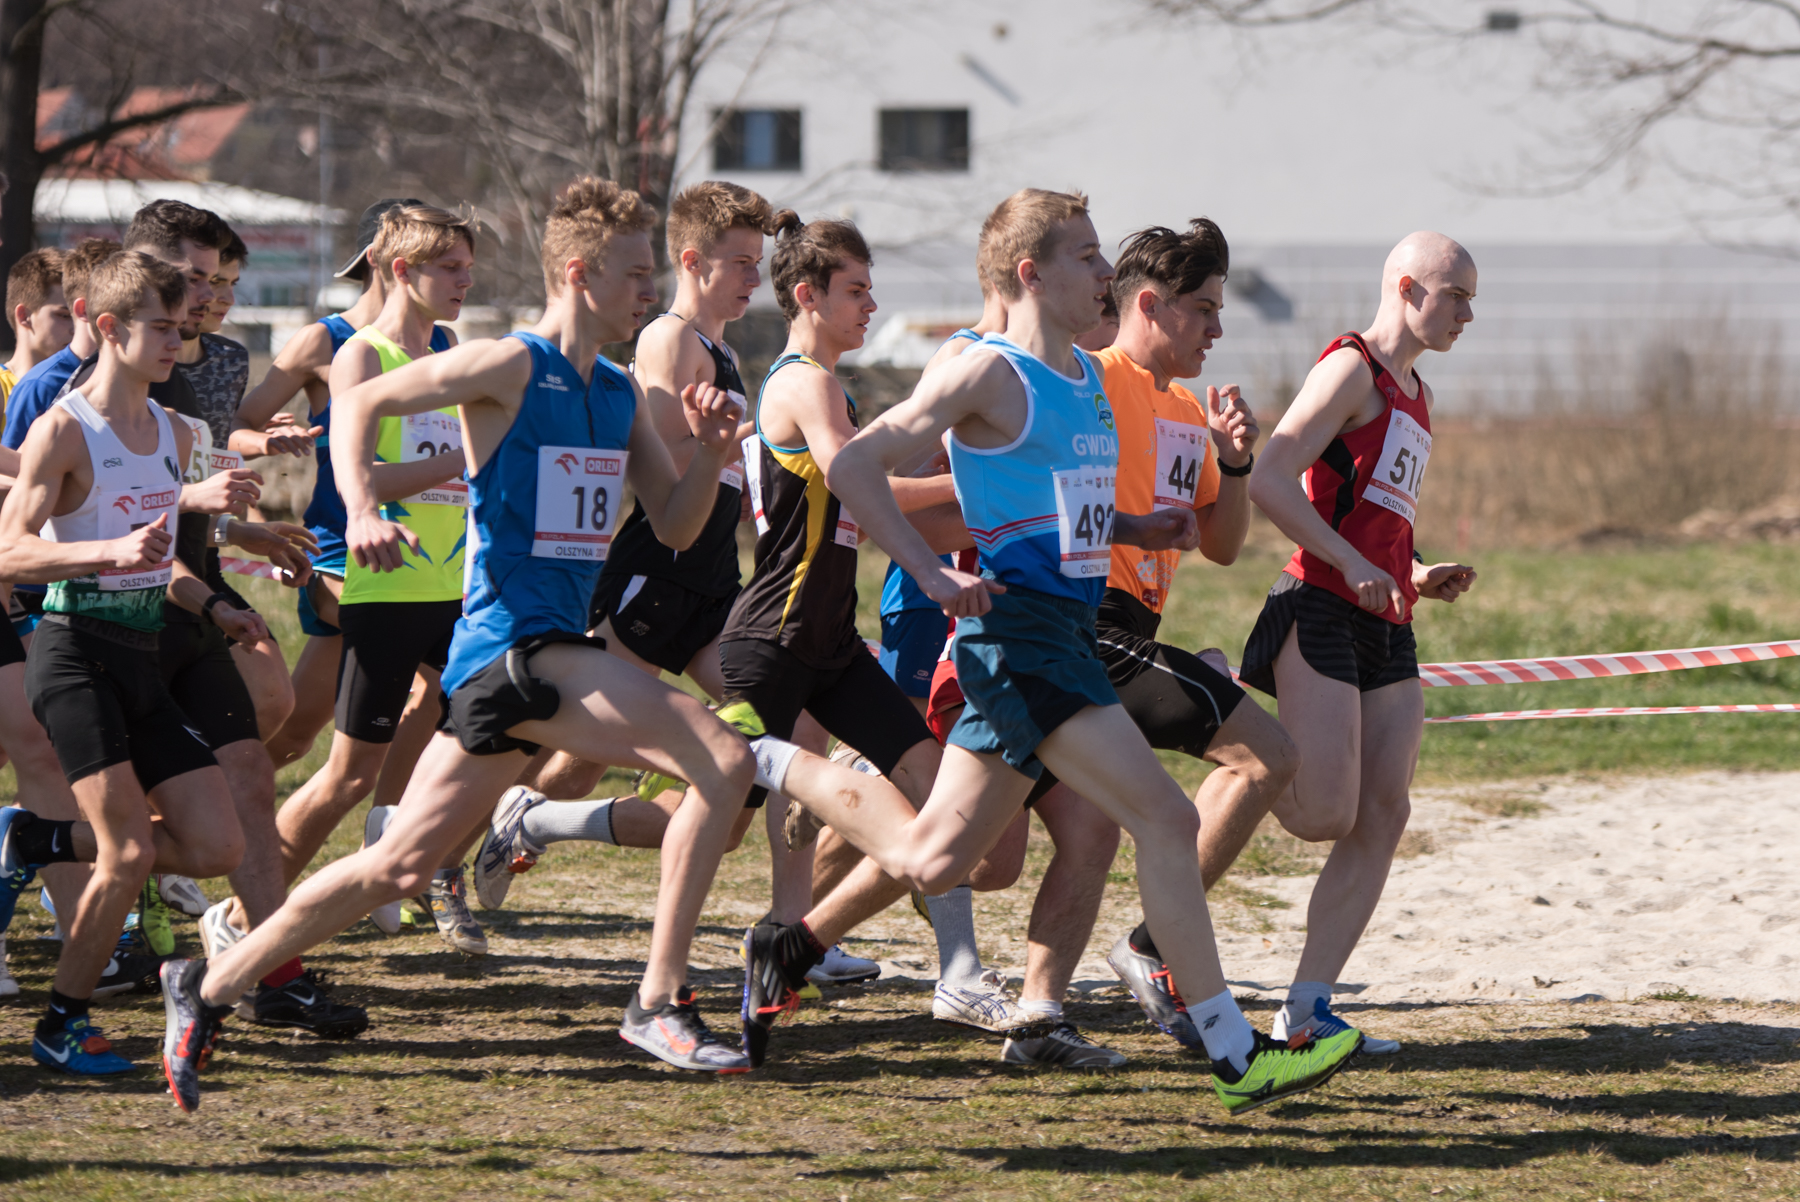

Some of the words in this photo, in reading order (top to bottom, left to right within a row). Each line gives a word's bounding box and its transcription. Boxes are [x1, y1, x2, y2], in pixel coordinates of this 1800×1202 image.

[1072, 434, 1117, 457] GWDA
[586, 459, 619, 473] ORLEN
[1389, 447, 1424, 500] 516
[142, 492, 174, 508] ORLEN
[421, 492, 450, 502] OLSZYNA
[571, 486, 607, 531] 18
[1382, 496, 1408, 516] OLSZYNA
[1075, 503, 1115, 546] 492
[555, 545, 594, 557] OLSZYNA
[1081, 564, 1101, 575] OLSZYNA
[119, 575, 157, 588] OLSZYNA
